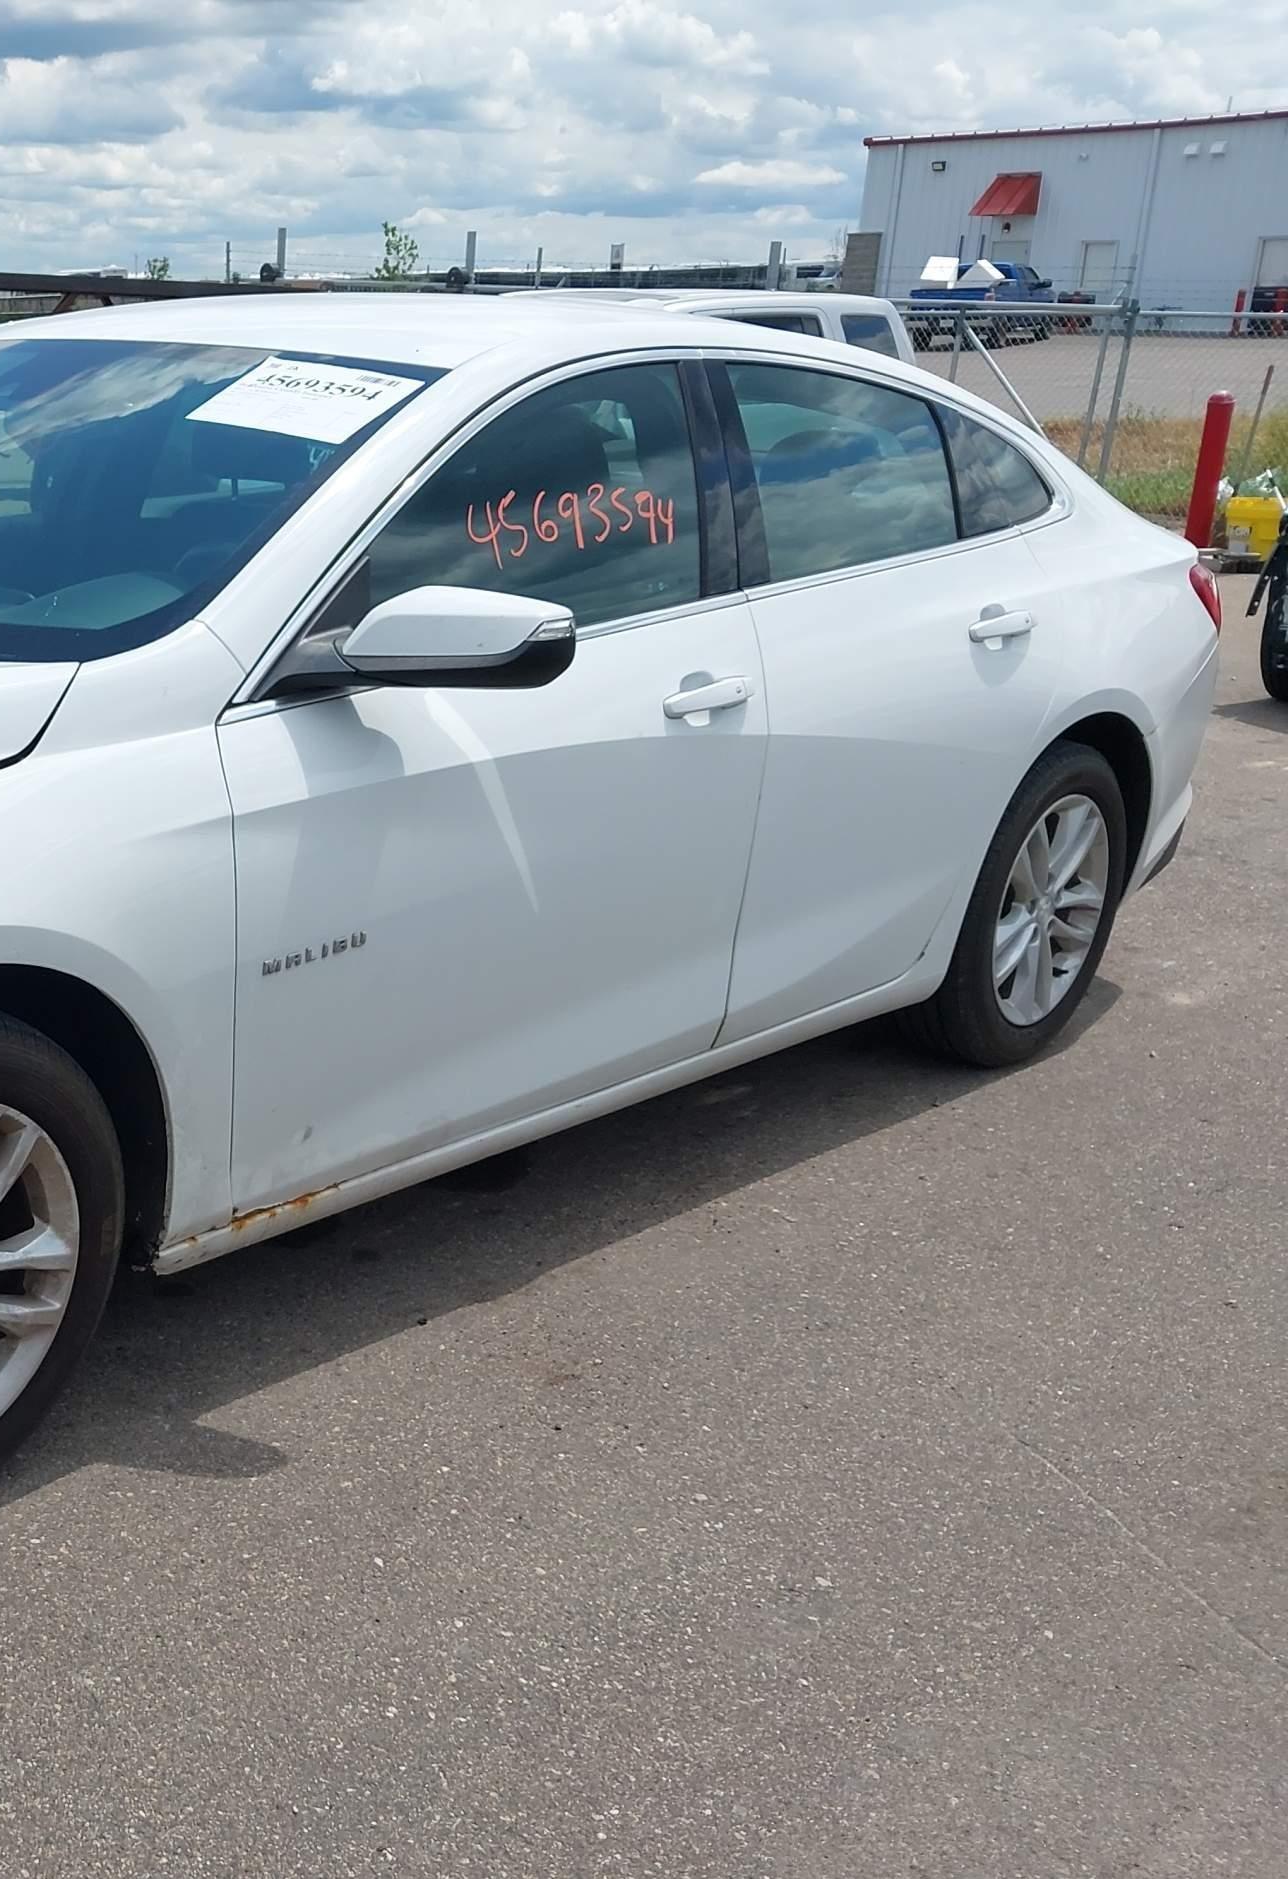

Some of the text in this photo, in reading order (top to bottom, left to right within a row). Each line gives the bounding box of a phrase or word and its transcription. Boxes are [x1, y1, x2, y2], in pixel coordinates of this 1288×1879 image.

[256, 373, 383, 401] 45693594
[467, 483, 675, 570] 45693594
[262, 930, 368, 976] MALIBU
